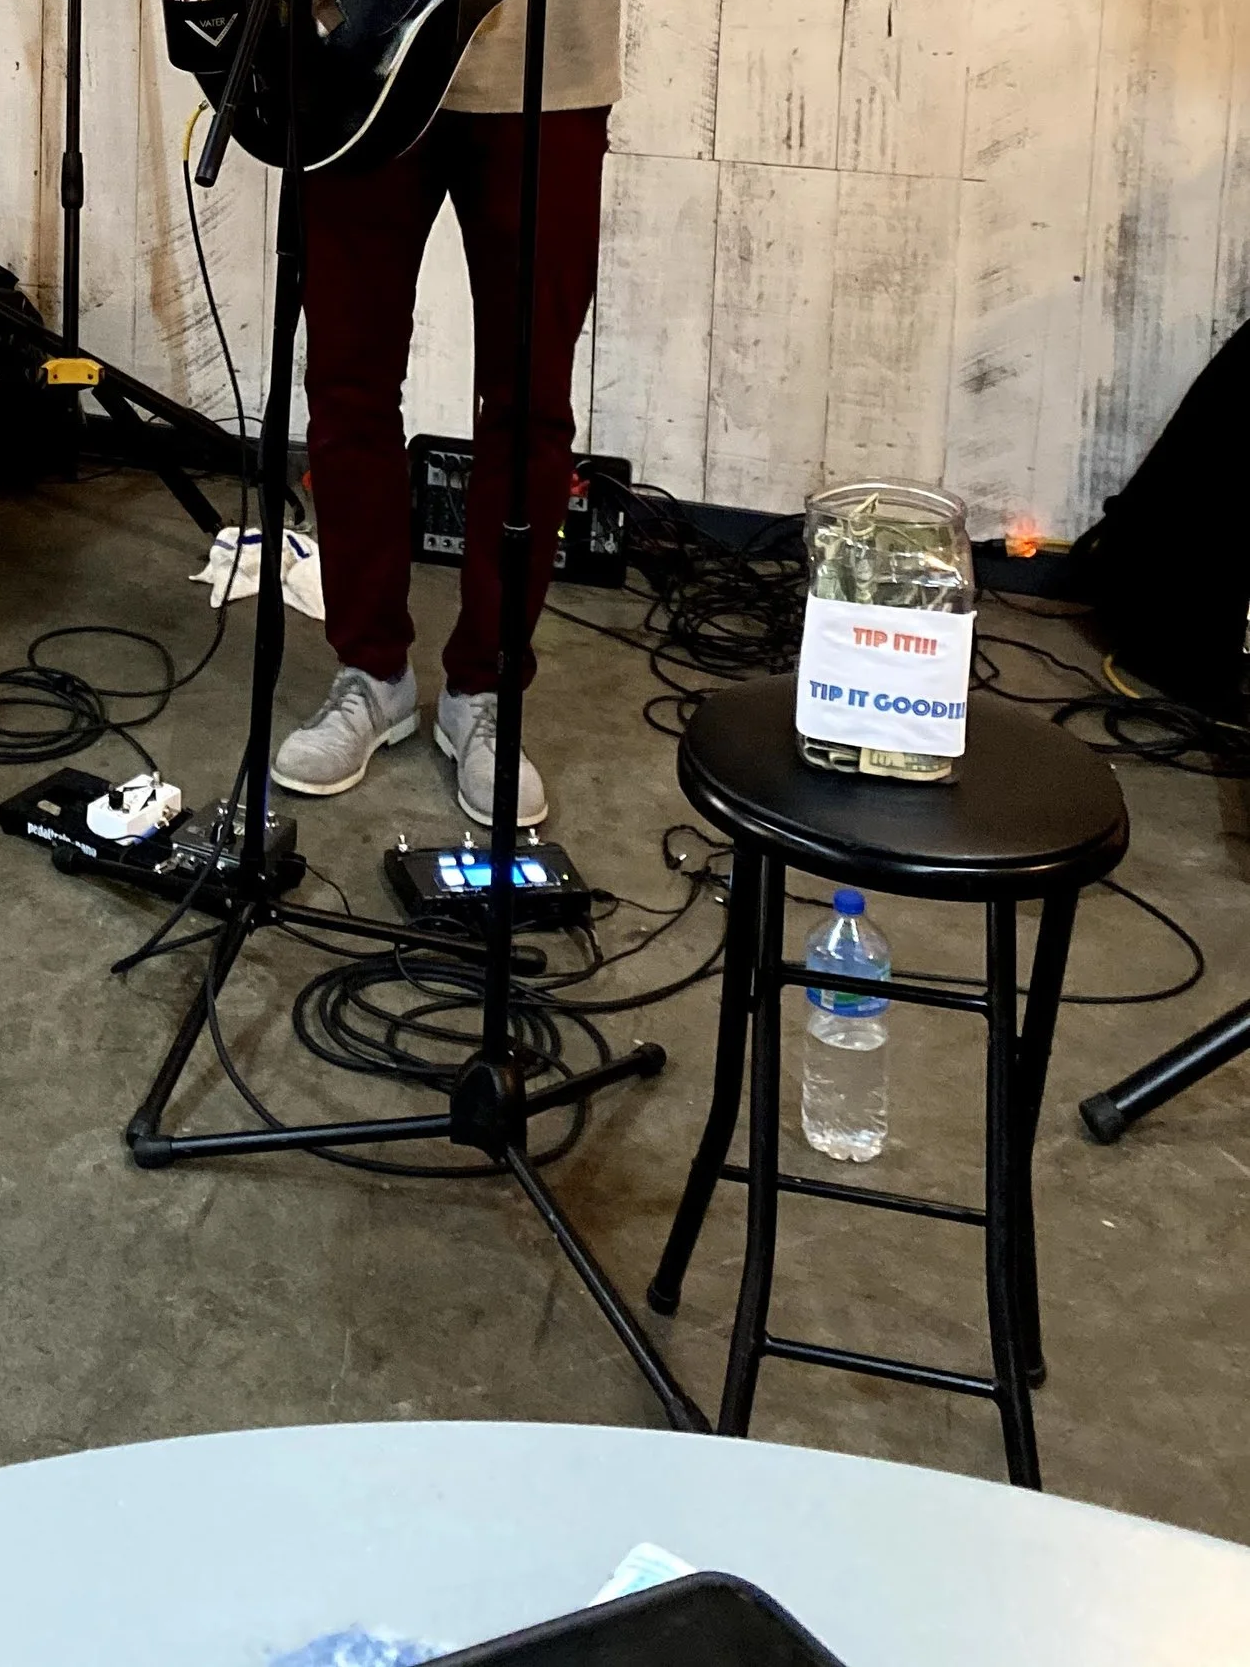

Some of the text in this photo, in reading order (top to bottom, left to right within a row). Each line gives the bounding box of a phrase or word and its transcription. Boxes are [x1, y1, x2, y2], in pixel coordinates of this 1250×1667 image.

[199, 17, 226, 28] VATER
[853, 627, 937, 656] TIP IT!!!
[809, 680, 965, 720] TIP IT GOOD!!!
